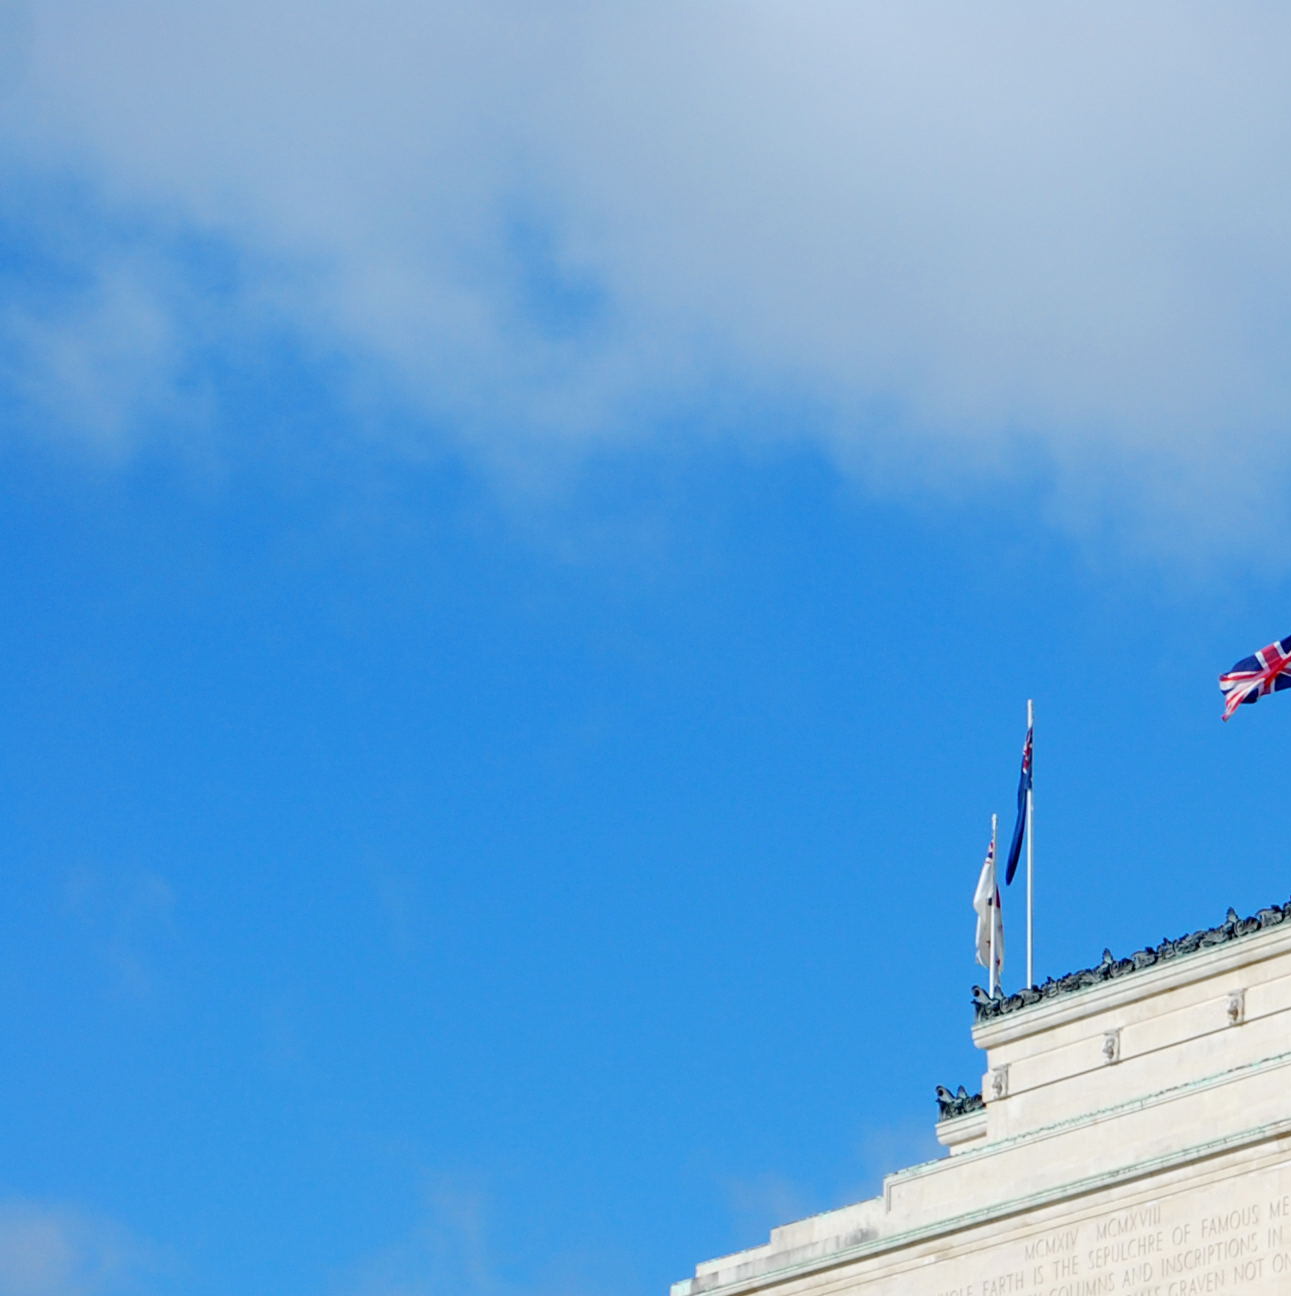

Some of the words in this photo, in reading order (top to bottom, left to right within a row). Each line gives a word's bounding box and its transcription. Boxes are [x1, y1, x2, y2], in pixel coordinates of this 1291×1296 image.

[1025, 1229, 1079, 1261] MCMXIV
[1096, 1205, 1160, 1241] MCMXVIII
[1033, 1265, 1045, 1286] IS
[1053, 1255, 1079, 1280] THE
[1088, 1231, 1163, 1270] SEPULCHRE
[1171, 1223, 1190, 1246] OF
[1201, 1204, 1259, 1239] FAMOUS
[1122, 1262, 1153, 1289] AND
[1161, 1232, 1258, 1279] INSCRIPTIONS
[1268, 1225, 1283, 1249] IN
[1234, 1257, 1264, 1285] NOT
